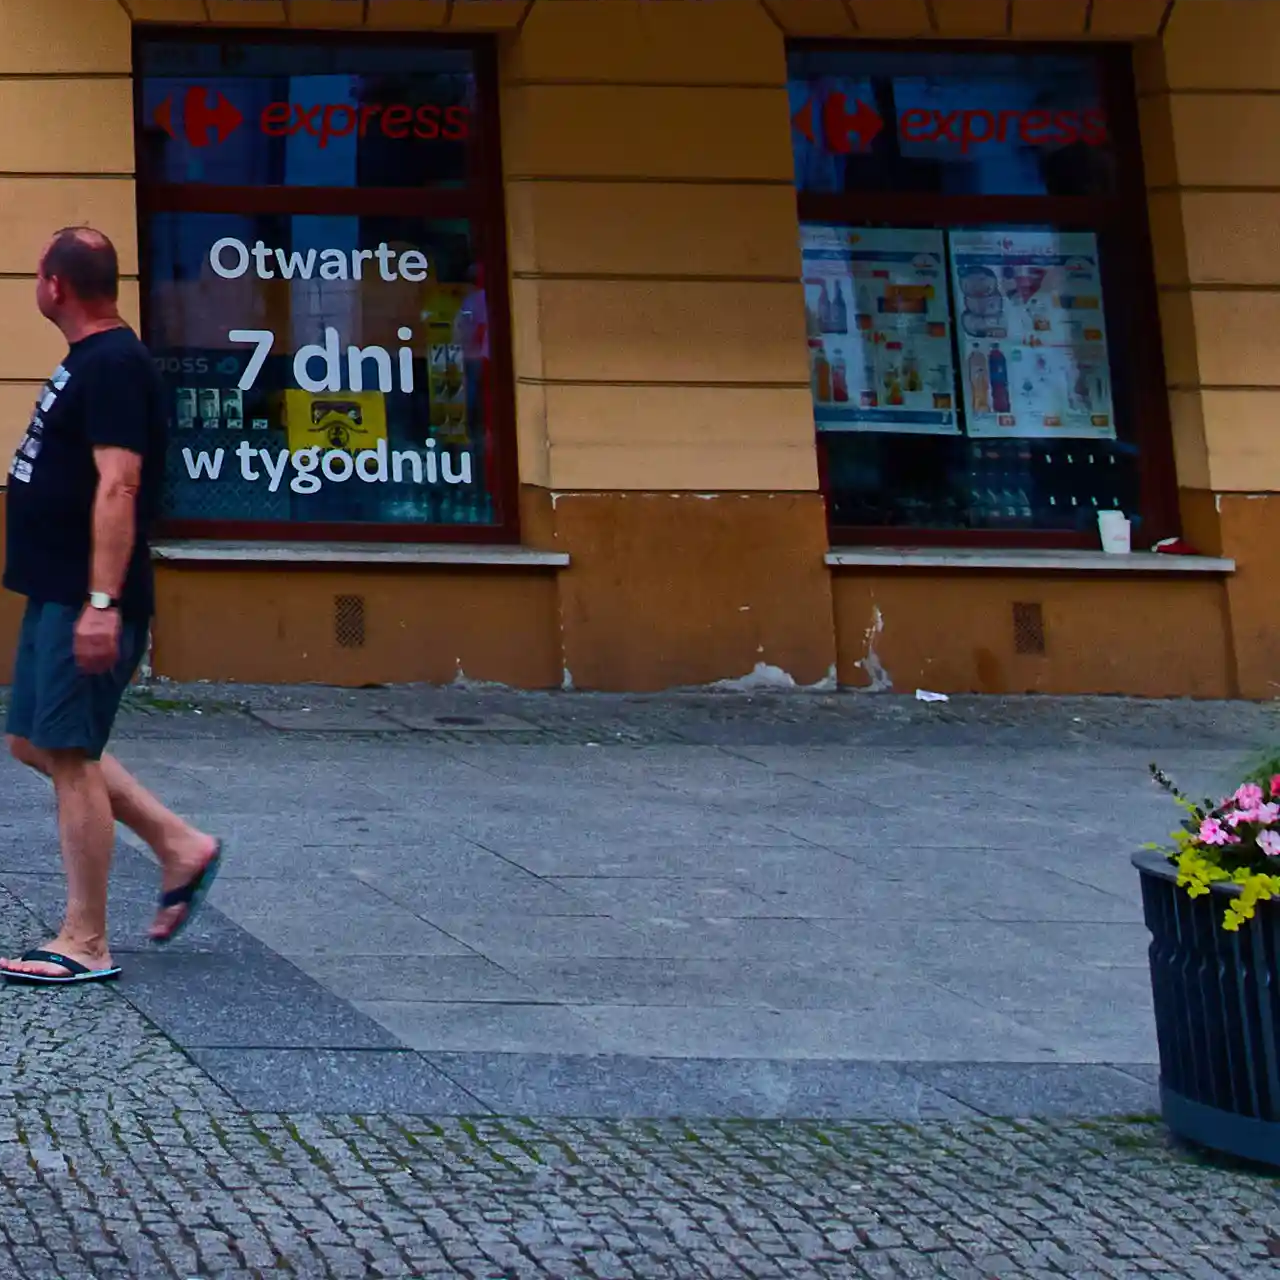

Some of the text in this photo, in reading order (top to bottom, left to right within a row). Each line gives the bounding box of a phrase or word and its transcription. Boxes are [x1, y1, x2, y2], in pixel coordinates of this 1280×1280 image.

[260, 101, 470, 149] express
[900, 108, 1108, 154] express
[209, 237, 428, 282] Otwarte
[228, 329, 275, 391] 7
[293, 326, 414, 393] dni
[182, 438, 473, 494] w tygodniu
